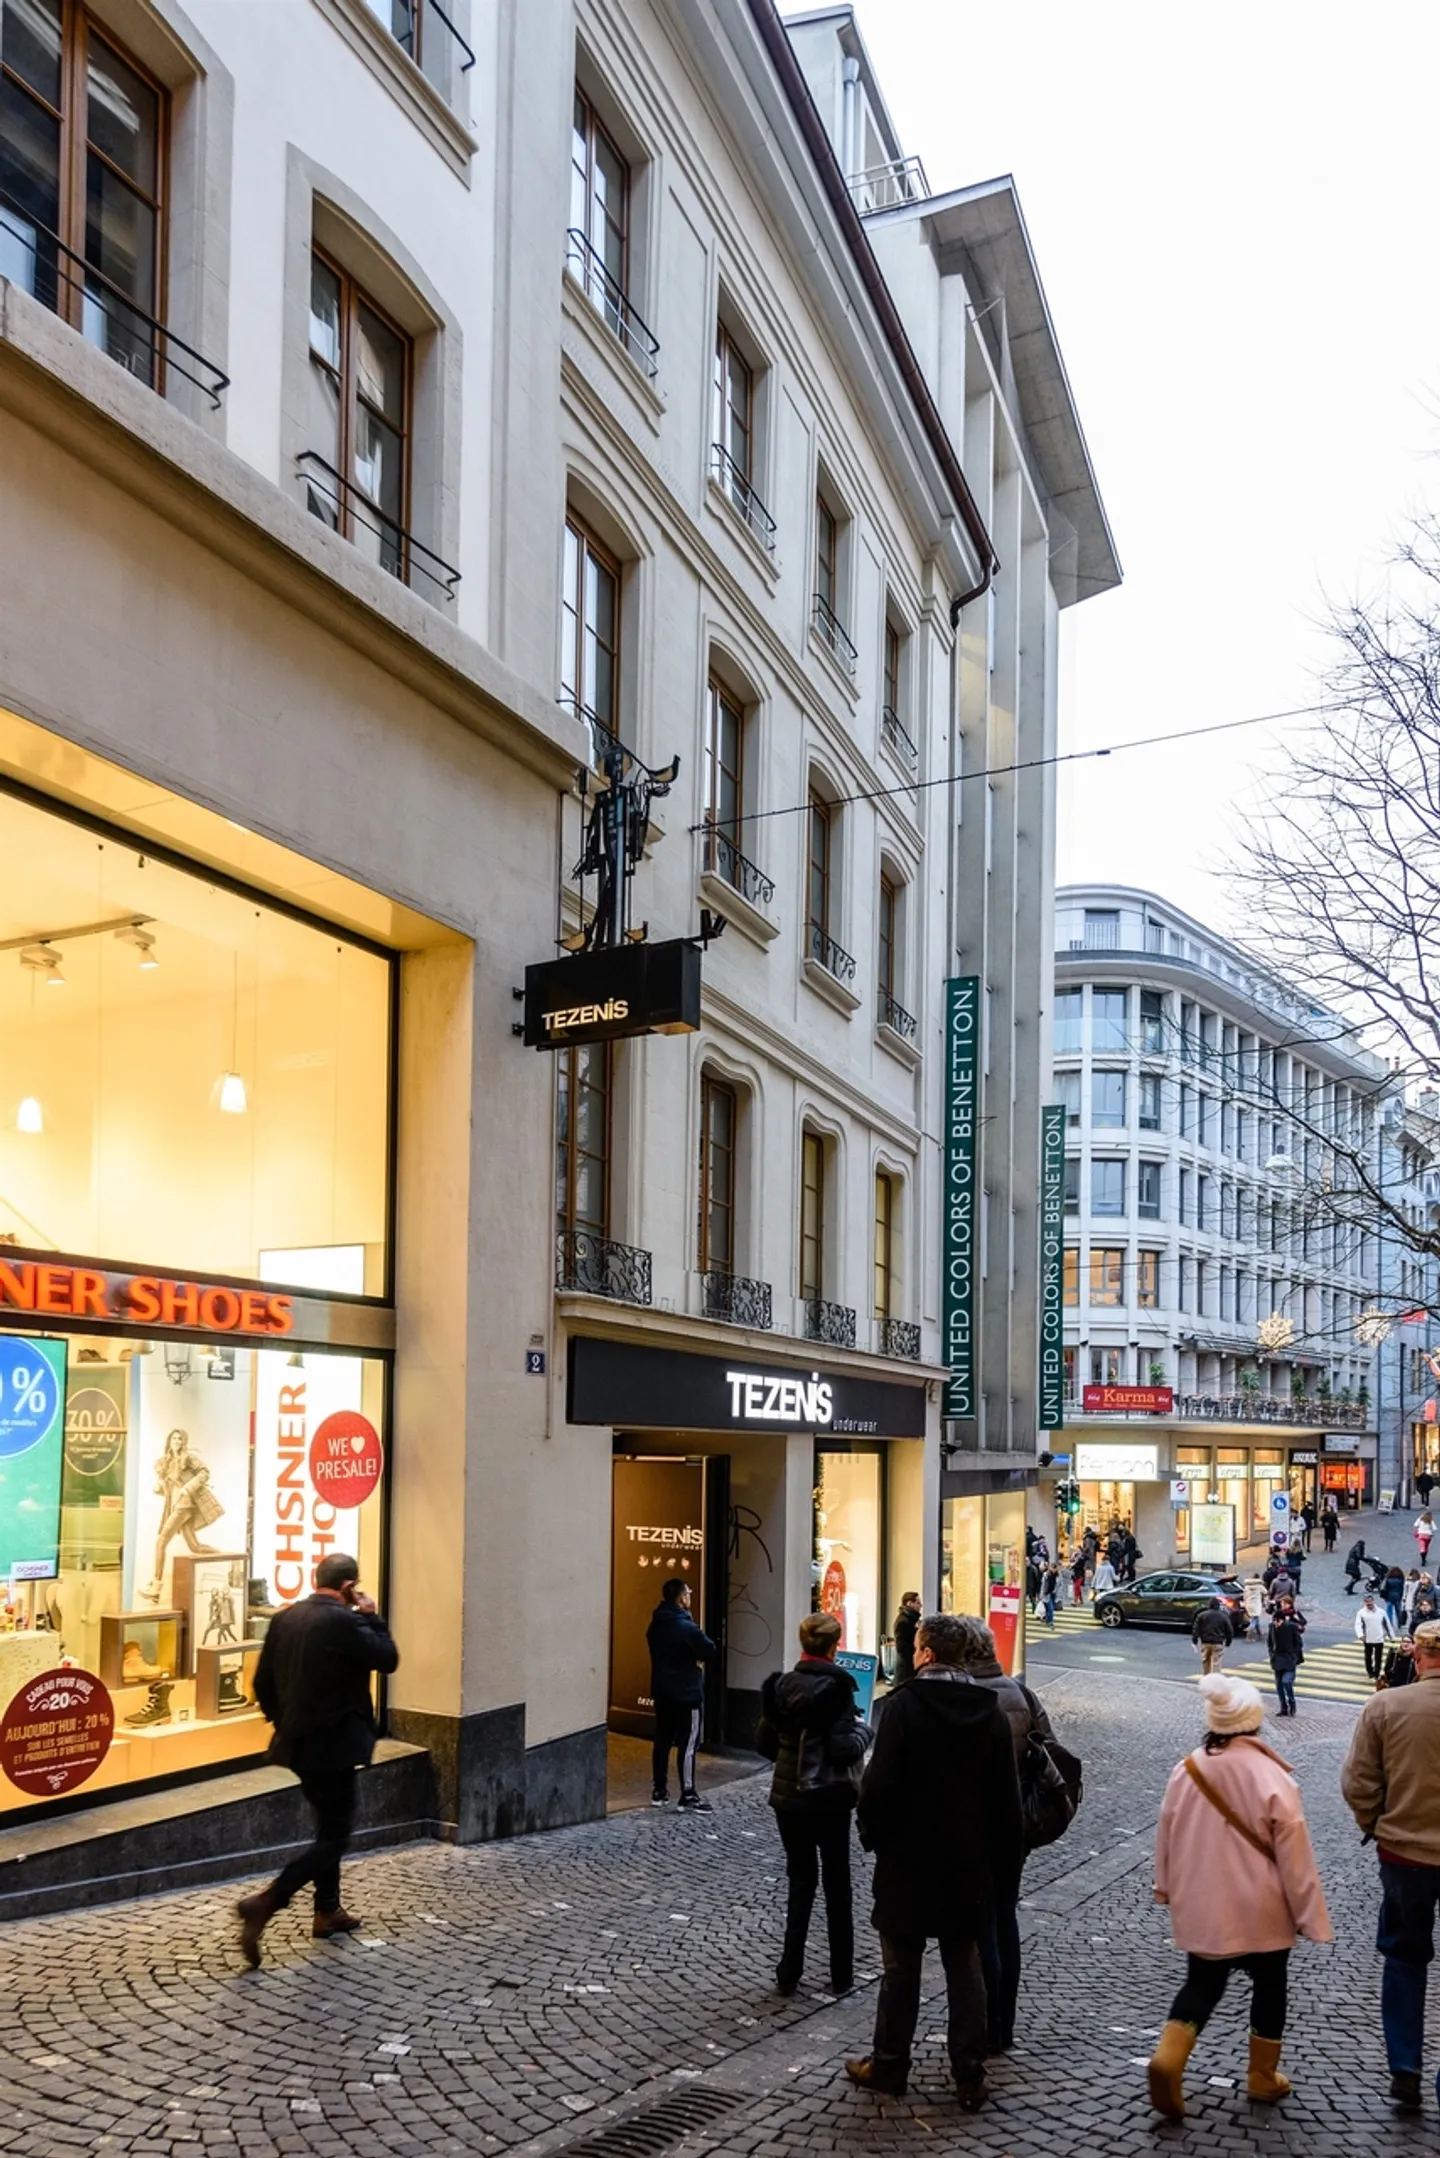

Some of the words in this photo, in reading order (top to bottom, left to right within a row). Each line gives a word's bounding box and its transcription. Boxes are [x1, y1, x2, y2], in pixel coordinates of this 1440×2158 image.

[952, 981, 973, 1137] BENETTON.
[951, 1149, 972, 1183] OF
[950, 1192, 971, 1299] COLORS
[1044, 1231, 1060, 1257] OF
[127, 1275, 294, 1335] SHOES
[1044, 1262, 1060, 1341] COLORS
[532, 1354, 541, 1372] 2
[950, 1309, 970, 1412] UNITED
[1044, 1349, 1060, 1424] UNITED
[1103, 1389, 1156, 1403] Karma
[833, 1417, 878, 1432] underwear
[327, 1436, 349, 1457] WE
[316, 1458, 378, 1480] PRESALE!
[274, 1383, 306, 1608] CHSNER
[56, 1677, 76, 1688] POUR
[76, 1678, 94, 1695] VOUS
[49, 1692, 70, 1711] 20
